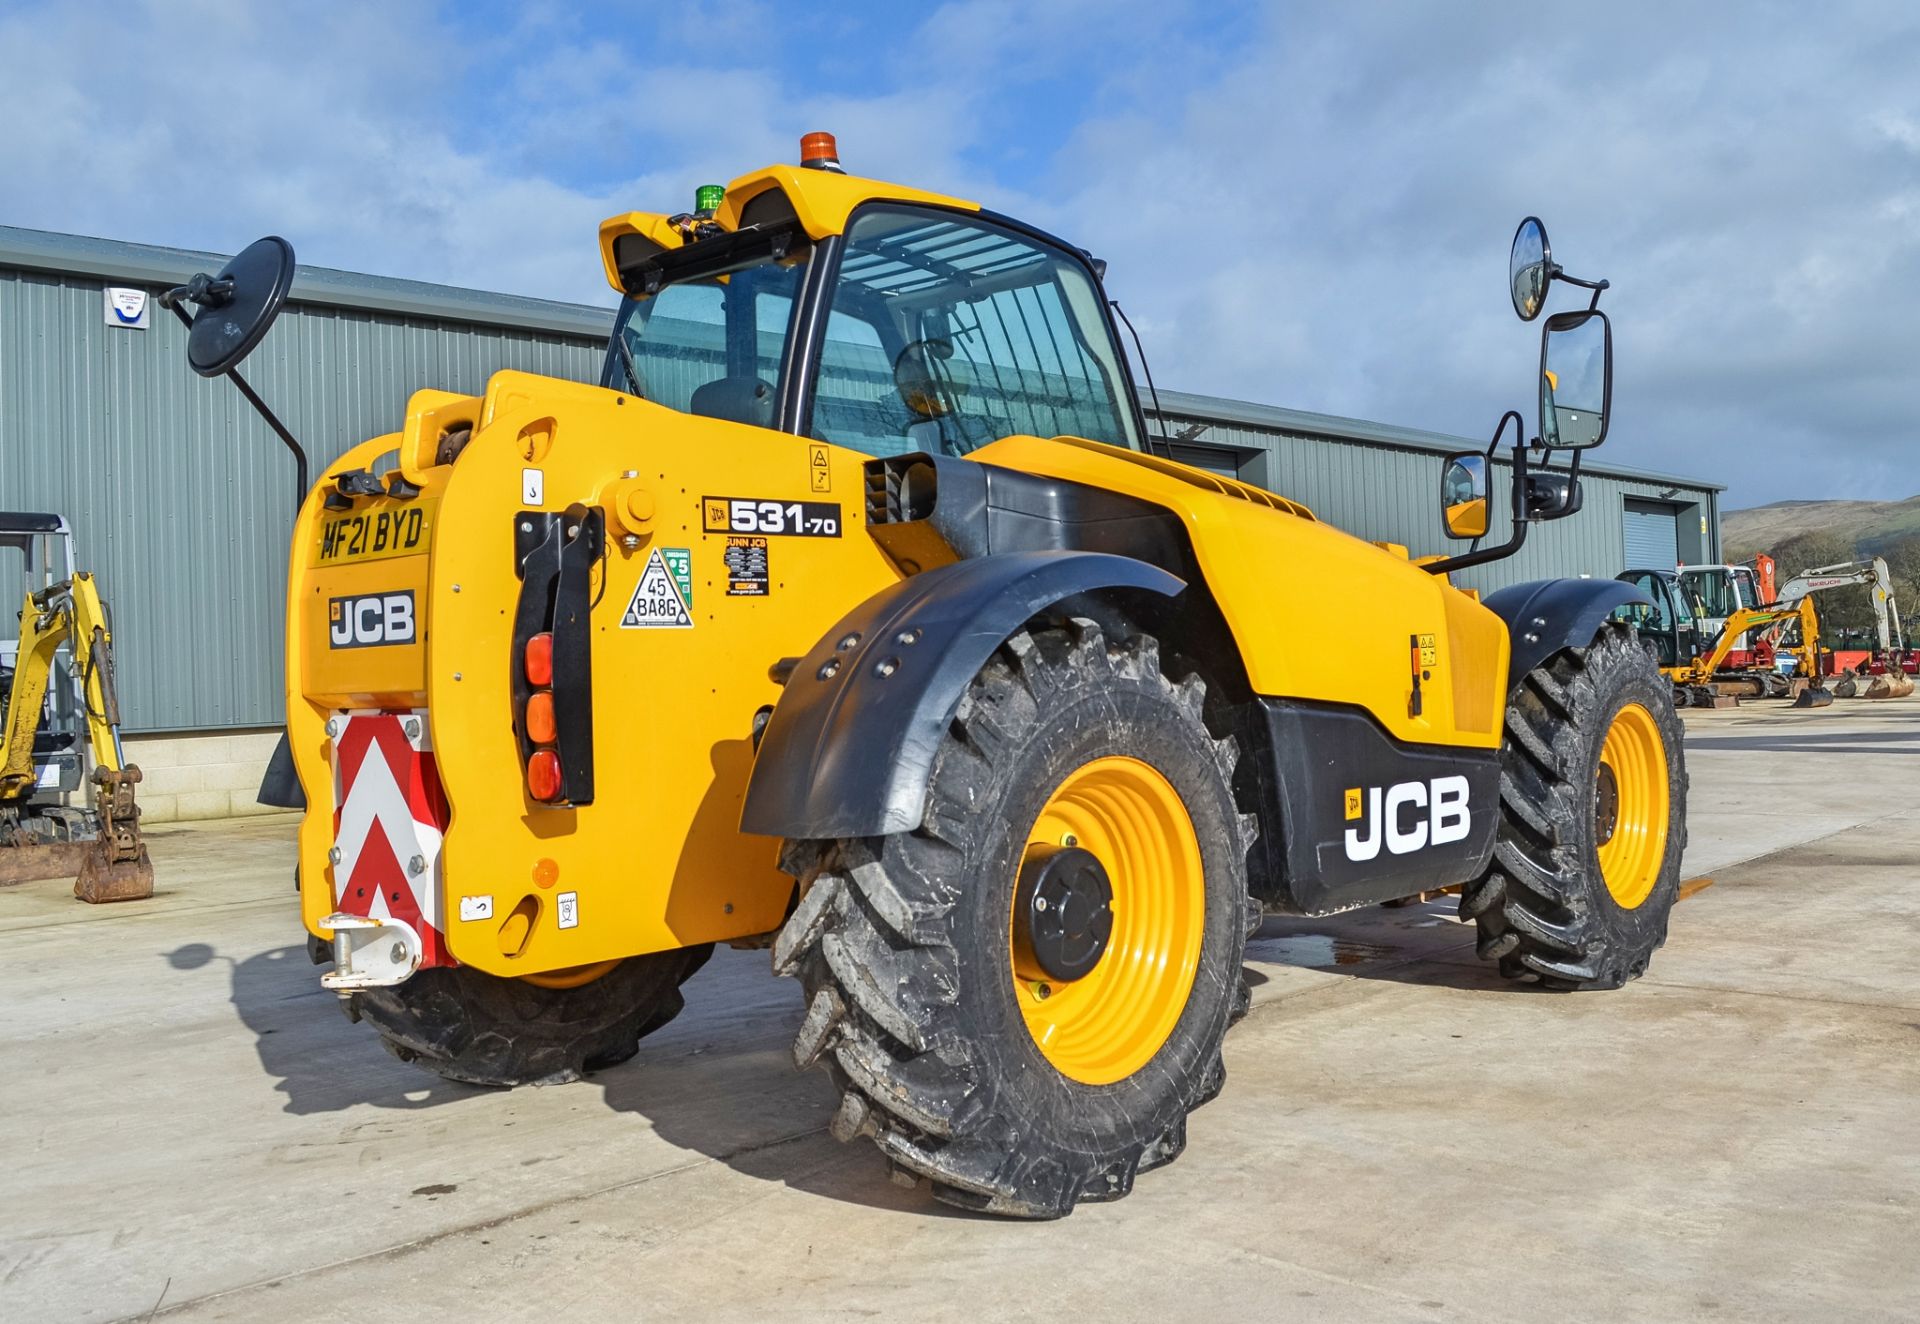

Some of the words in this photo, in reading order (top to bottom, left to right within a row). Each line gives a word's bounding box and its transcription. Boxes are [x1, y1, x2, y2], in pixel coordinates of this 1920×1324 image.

[711, 507, 726, 521] JCB
[730, 501, 837, 535] 531-70
[320, 515, 370, 560] MF21
[373, 507, 424, 552] BYD
[750, 539, 766, 548] JCB
[678, 559, 689, 575] 5
[648, 578, 667, 597] 45
[637, 598, 677, 617] BA8G
[331, 595, 414, 645] JCB
[1344, 775, 1471, 862] JCB
